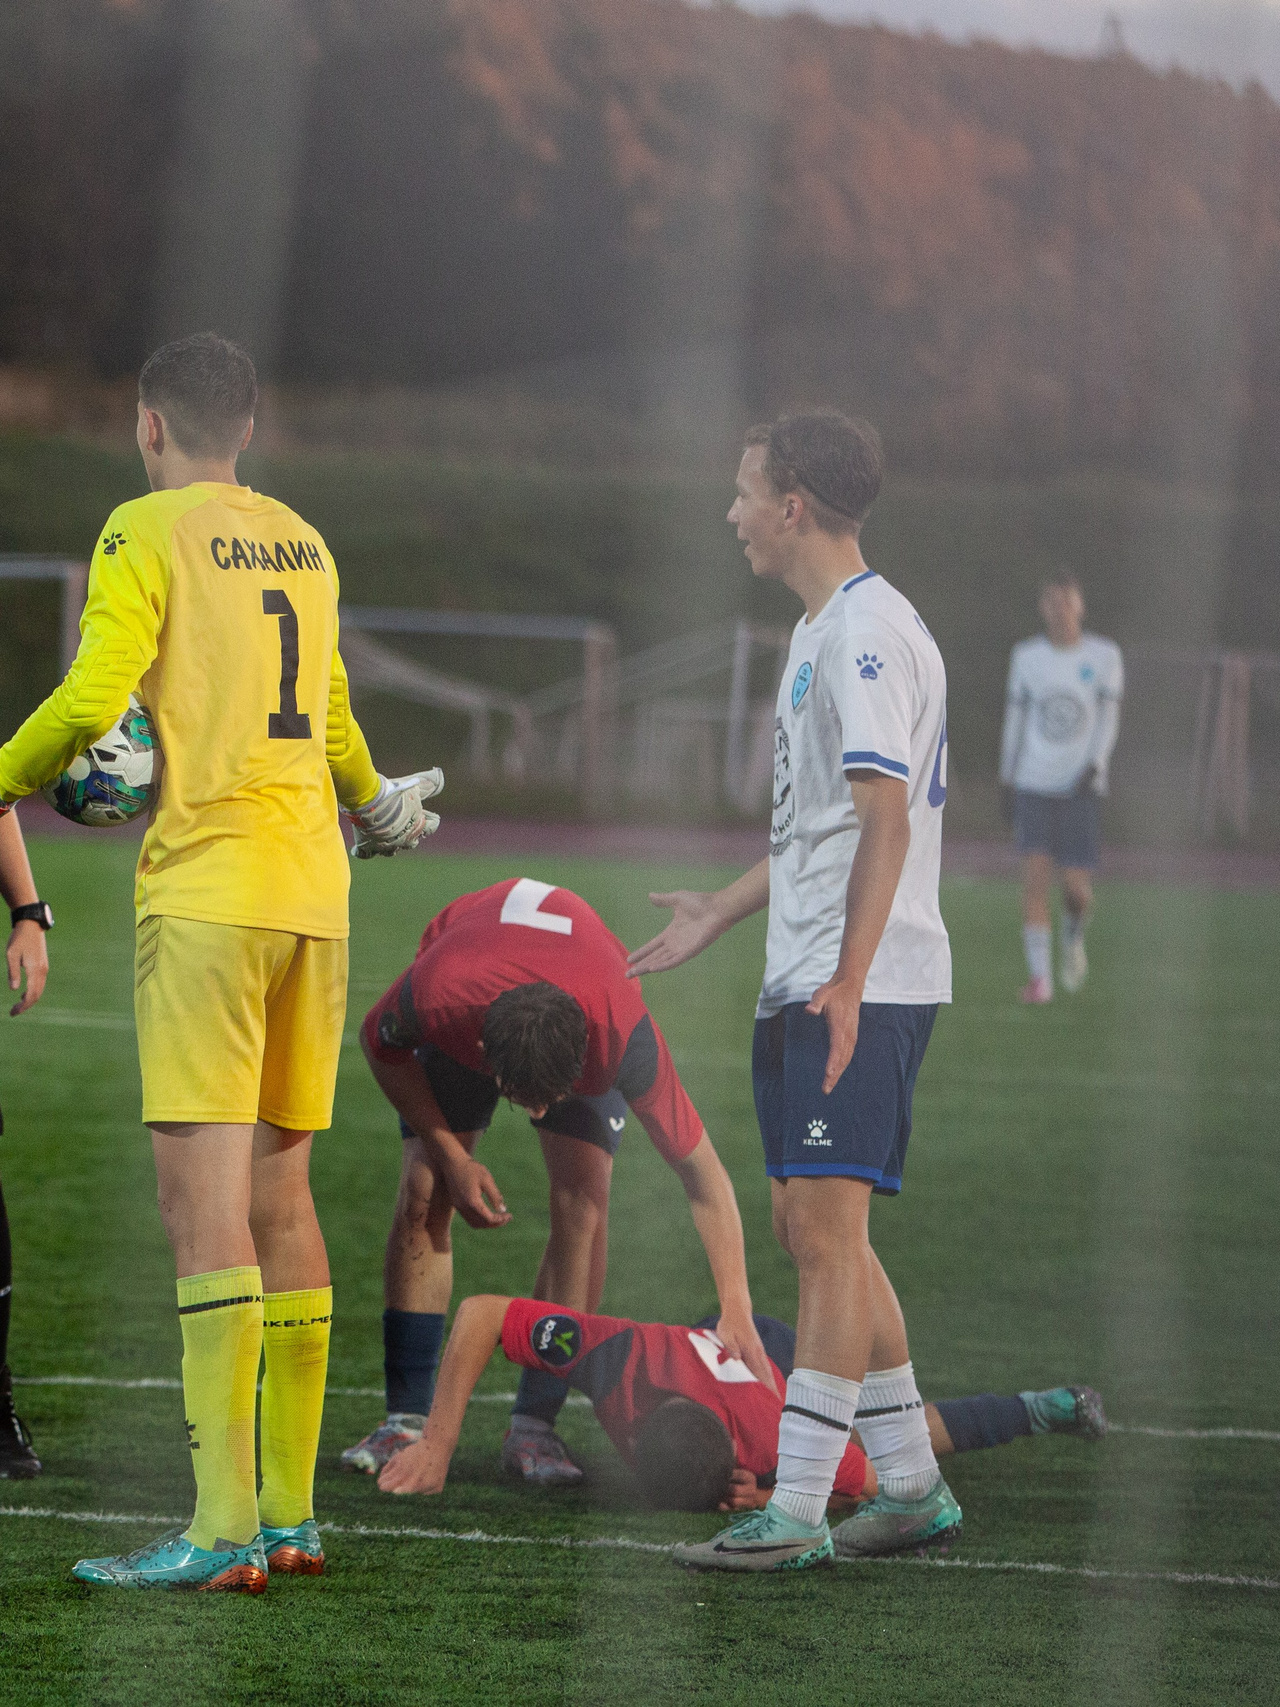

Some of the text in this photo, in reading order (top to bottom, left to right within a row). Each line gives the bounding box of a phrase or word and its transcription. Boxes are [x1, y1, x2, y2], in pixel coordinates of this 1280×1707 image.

[210, 536, 326, 573] САХАЛИН
[261, 589, 312, 739] 1
[802, 1138, 833, 1147] KELME
[269, 1314, 330, 1328] KELME
